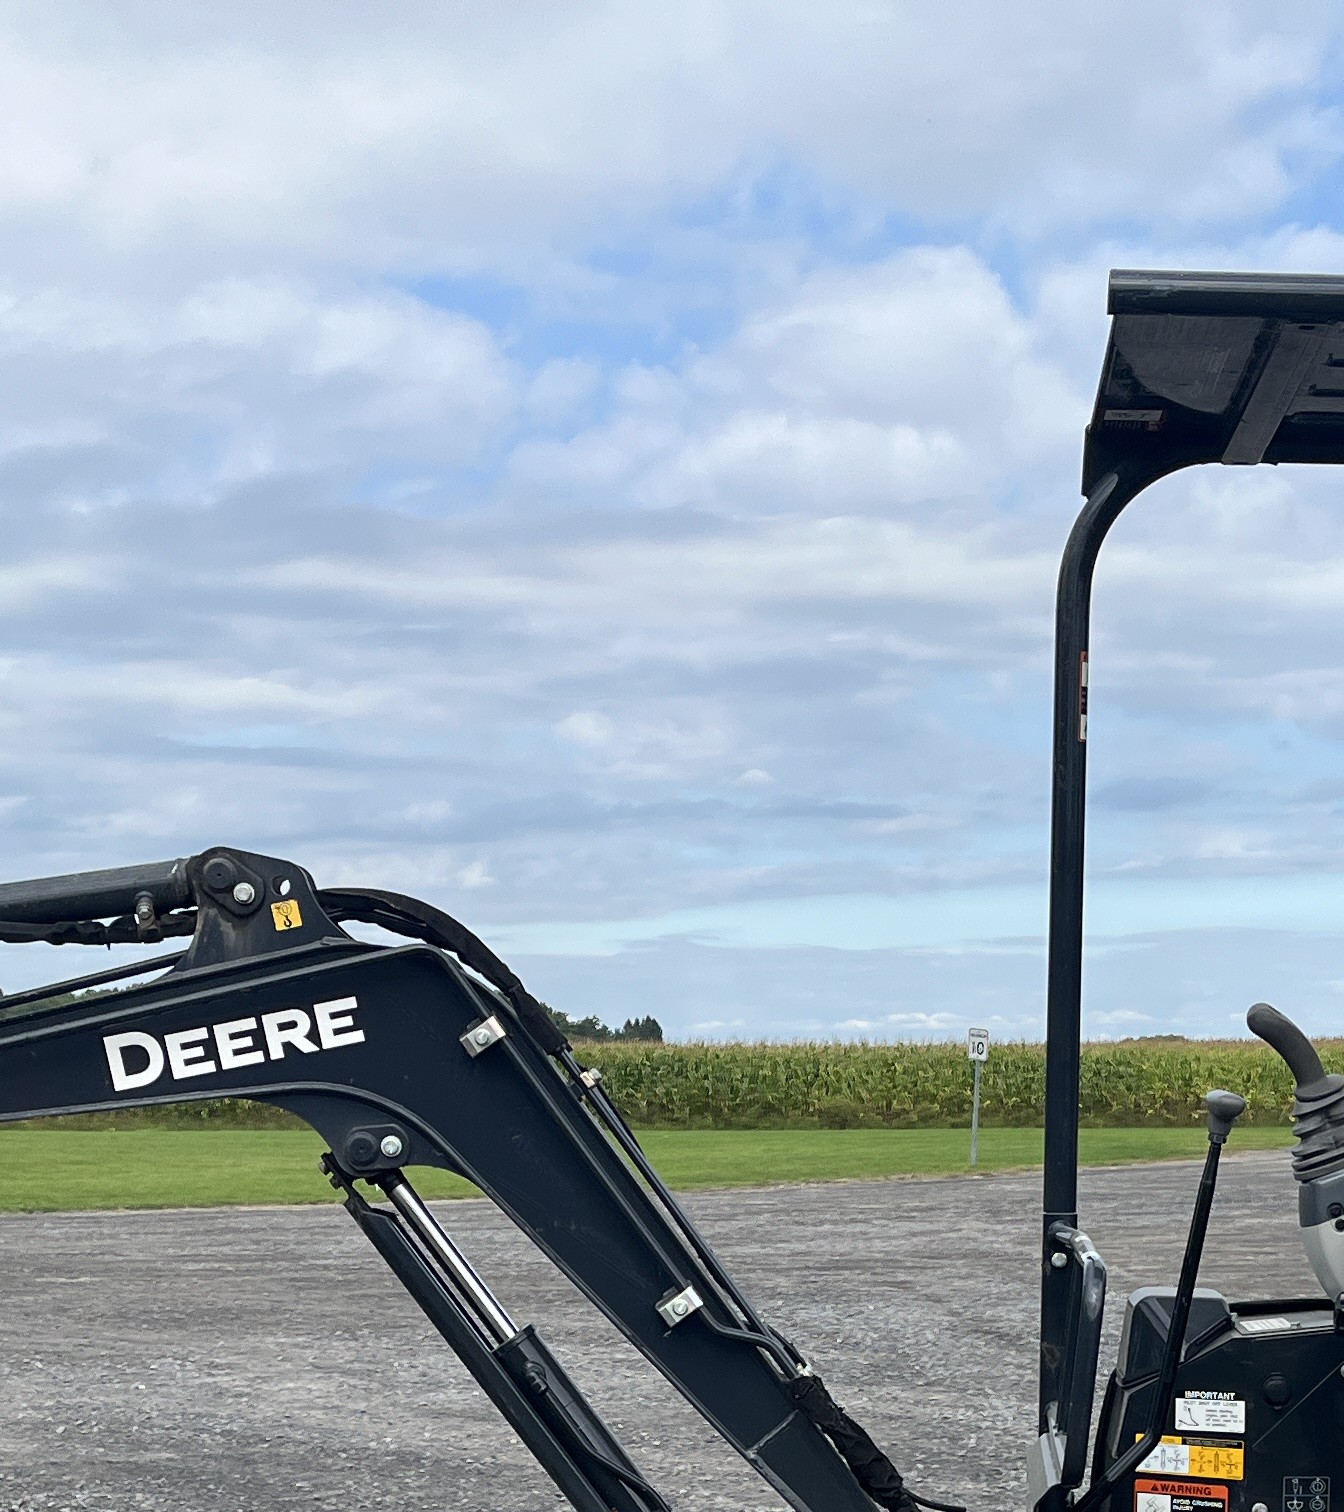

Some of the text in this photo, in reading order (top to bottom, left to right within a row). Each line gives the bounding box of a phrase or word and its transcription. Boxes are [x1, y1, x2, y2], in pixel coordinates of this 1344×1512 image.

[103, 996, 365, 1092] DEERE
[1184, 1391, 1235, 1400] IMPORTANT
[1159, 1483, 1212, 1496] WARNING
